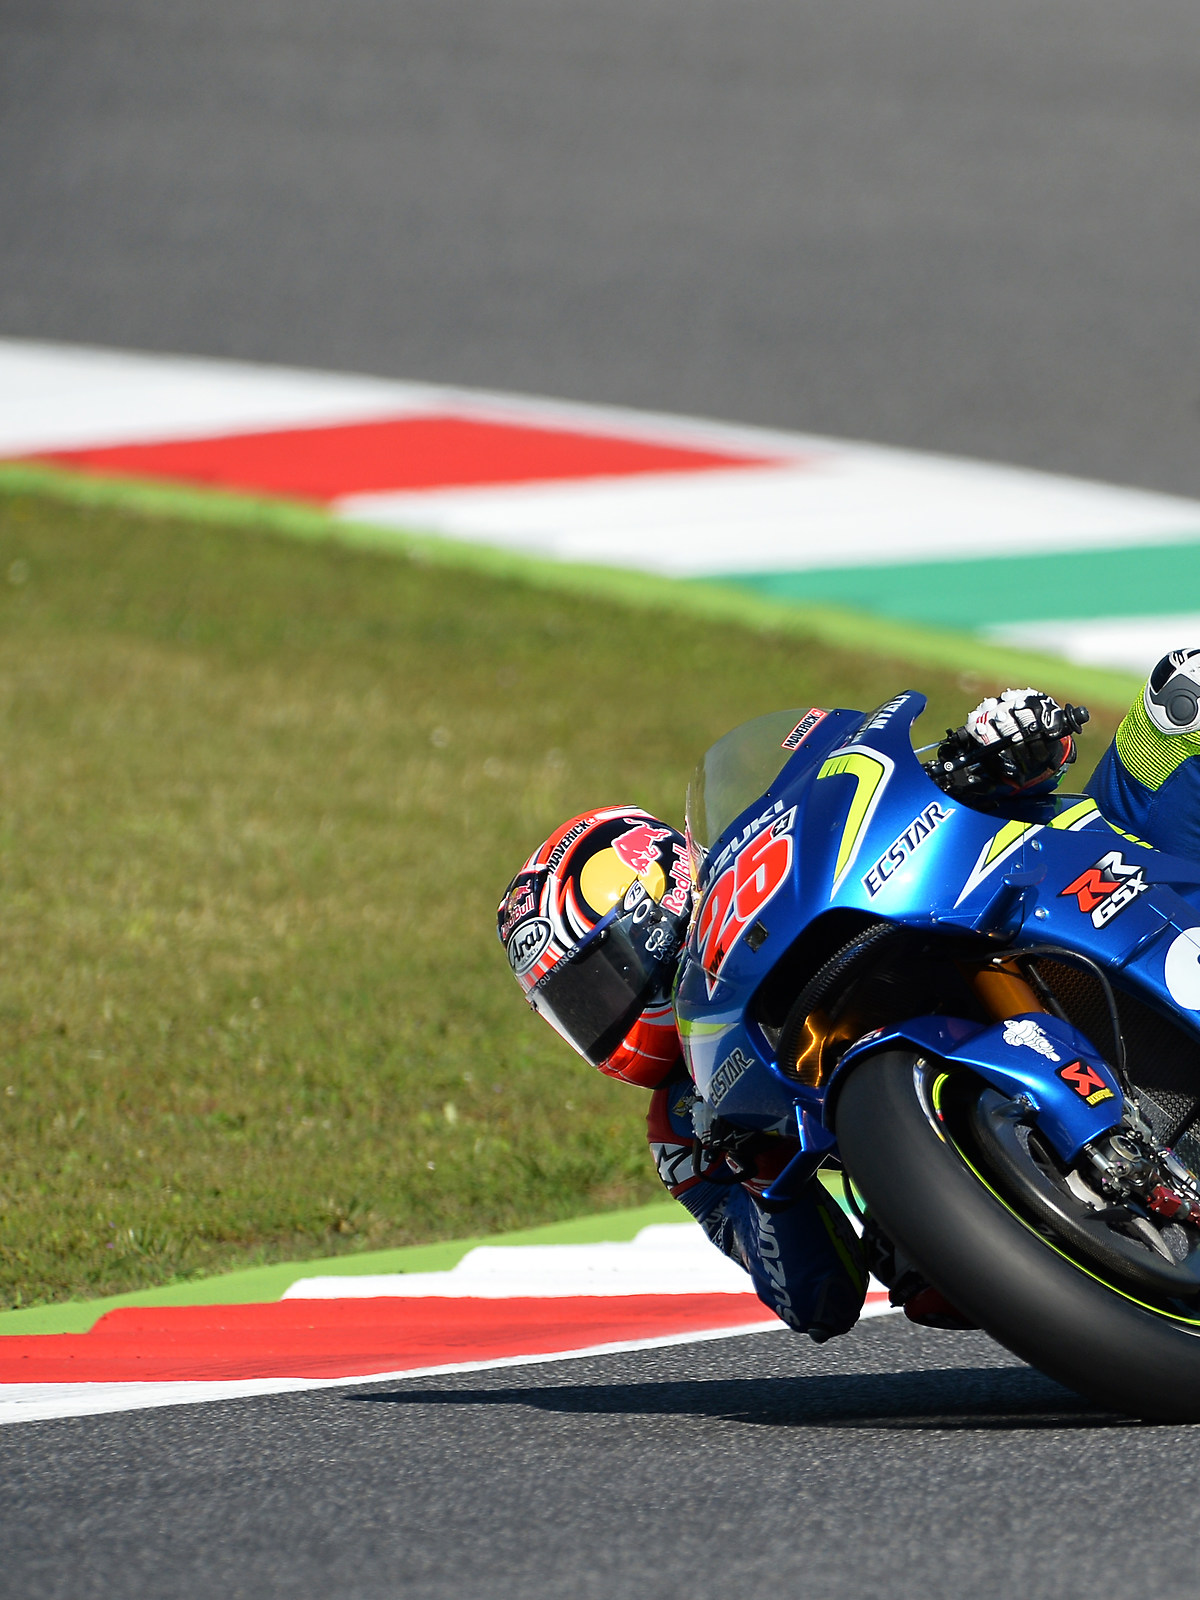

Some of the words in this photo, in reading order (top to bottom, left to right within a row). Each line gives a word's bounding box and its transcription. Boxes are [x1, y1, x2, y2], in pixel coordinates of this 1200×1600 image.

[783, 713, 820, 749] MAVERICK
[862, 802, 954, 899] ECSTAR
[660, 868, 692, 917] Red
[697, 806, 797, 1000] 25
[1091, 870, 1149, 928] GSX
[508, 919, 545, 968] Arai
[551, 945, 580, 974] WINGS
